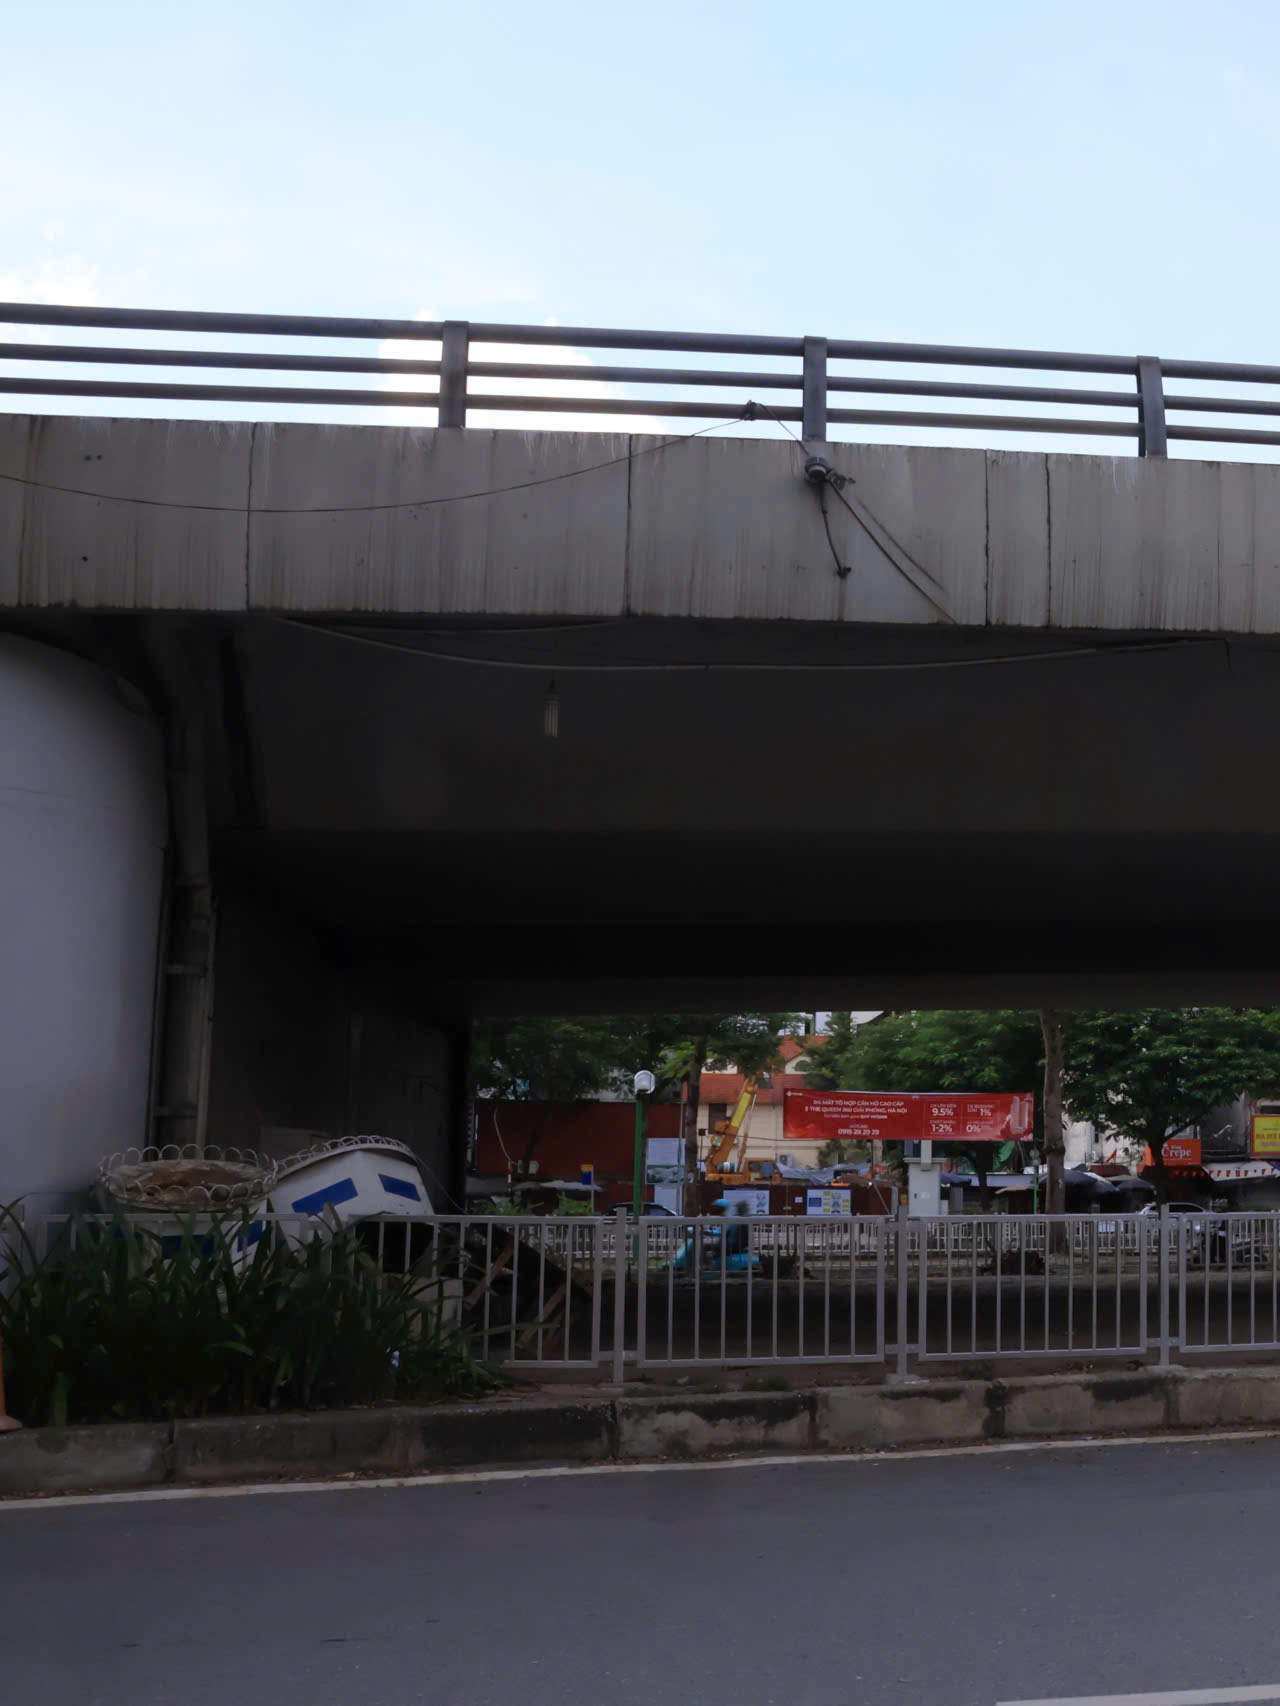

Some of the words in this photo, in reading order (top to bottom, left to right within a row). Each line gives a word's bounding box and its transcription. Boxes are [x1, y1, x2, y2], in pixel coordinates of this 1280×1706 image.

[931, 1107, 954, 1117] 9.5%
[980, 1108, 992, 1117] 1%
[966, 1124, 981, 1133] 0%
